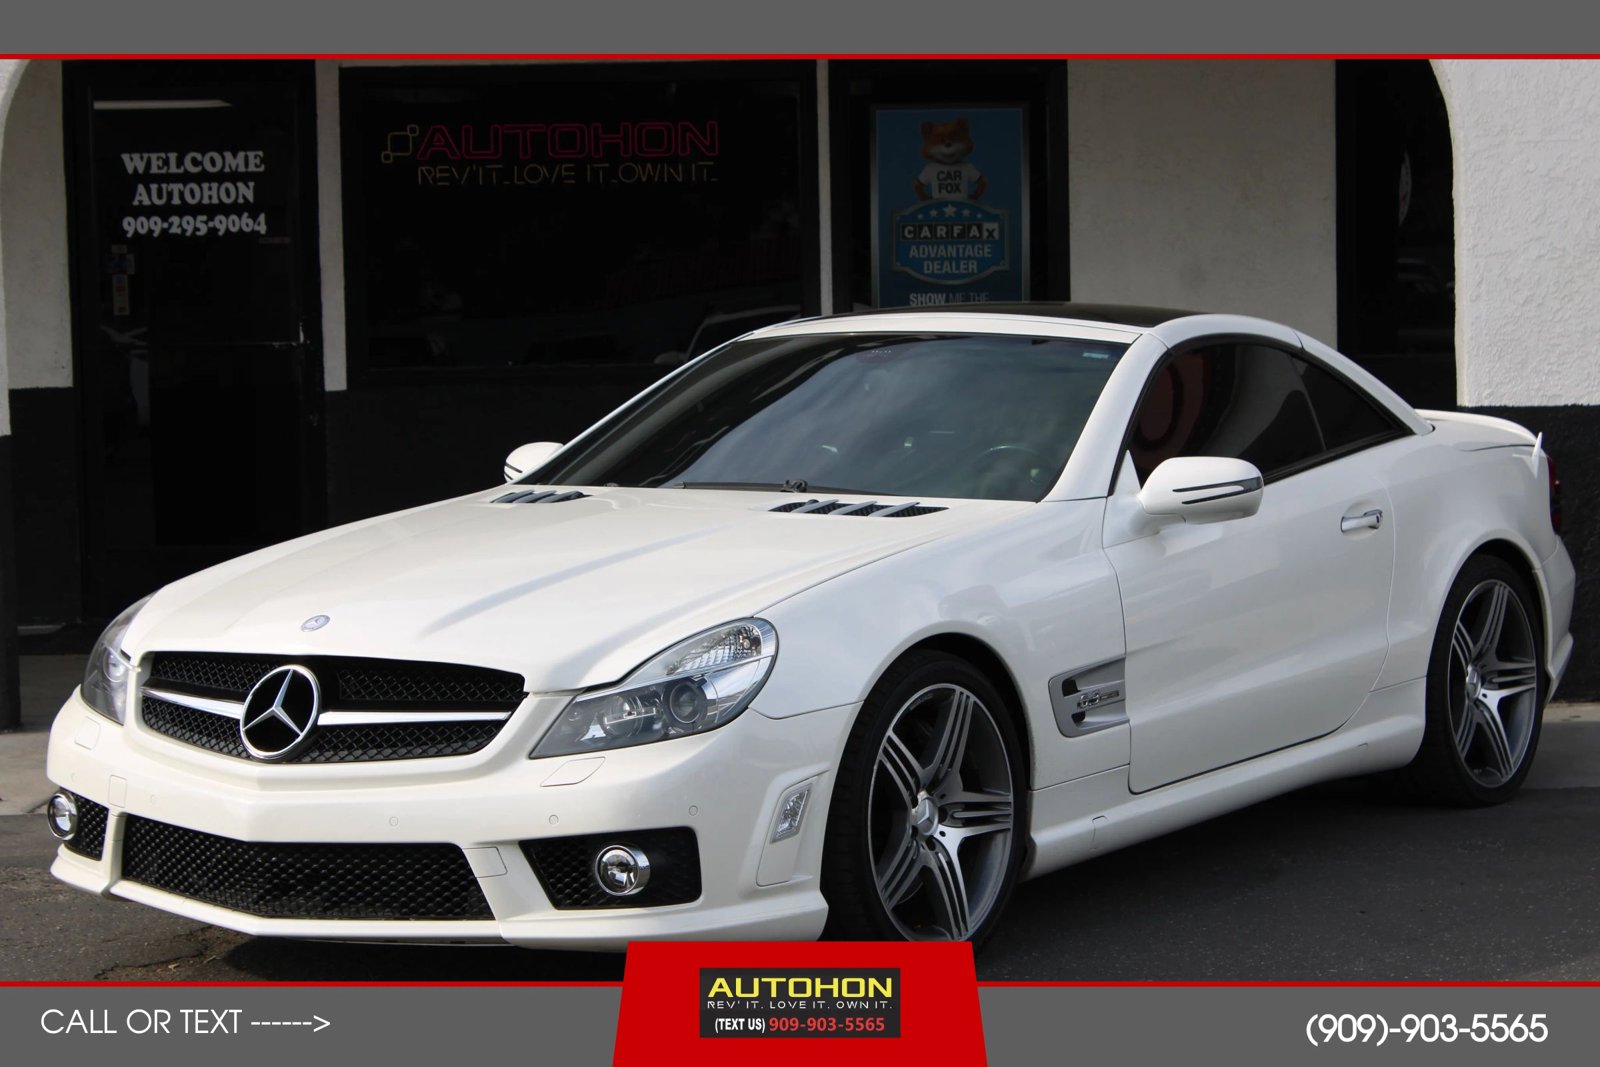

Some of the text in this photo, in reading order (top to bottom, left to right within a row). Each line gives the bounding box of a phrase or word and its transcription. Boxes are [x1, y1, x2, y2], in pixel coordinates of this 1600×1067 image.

[416, 120, 720, 162] AUTOHON
[121, 150, 266, 175] WELCOME
[513, 163, 576, 185] LOVE
[936, 169, 963, 182] CAR
[132, 181, 256, 206] AUTOHON
[938, 182, 962, 194] FOX
[121, 212, 267, 238] 909-295-9064
[902, 224, 999, 240] CARFAX
[909, 244, 993, 259] ADVANTAGE
[923, 260, 978, 275] DEALER
[909, 292, 946, 306] SHOW
[968, 292, 990, 304] THE
